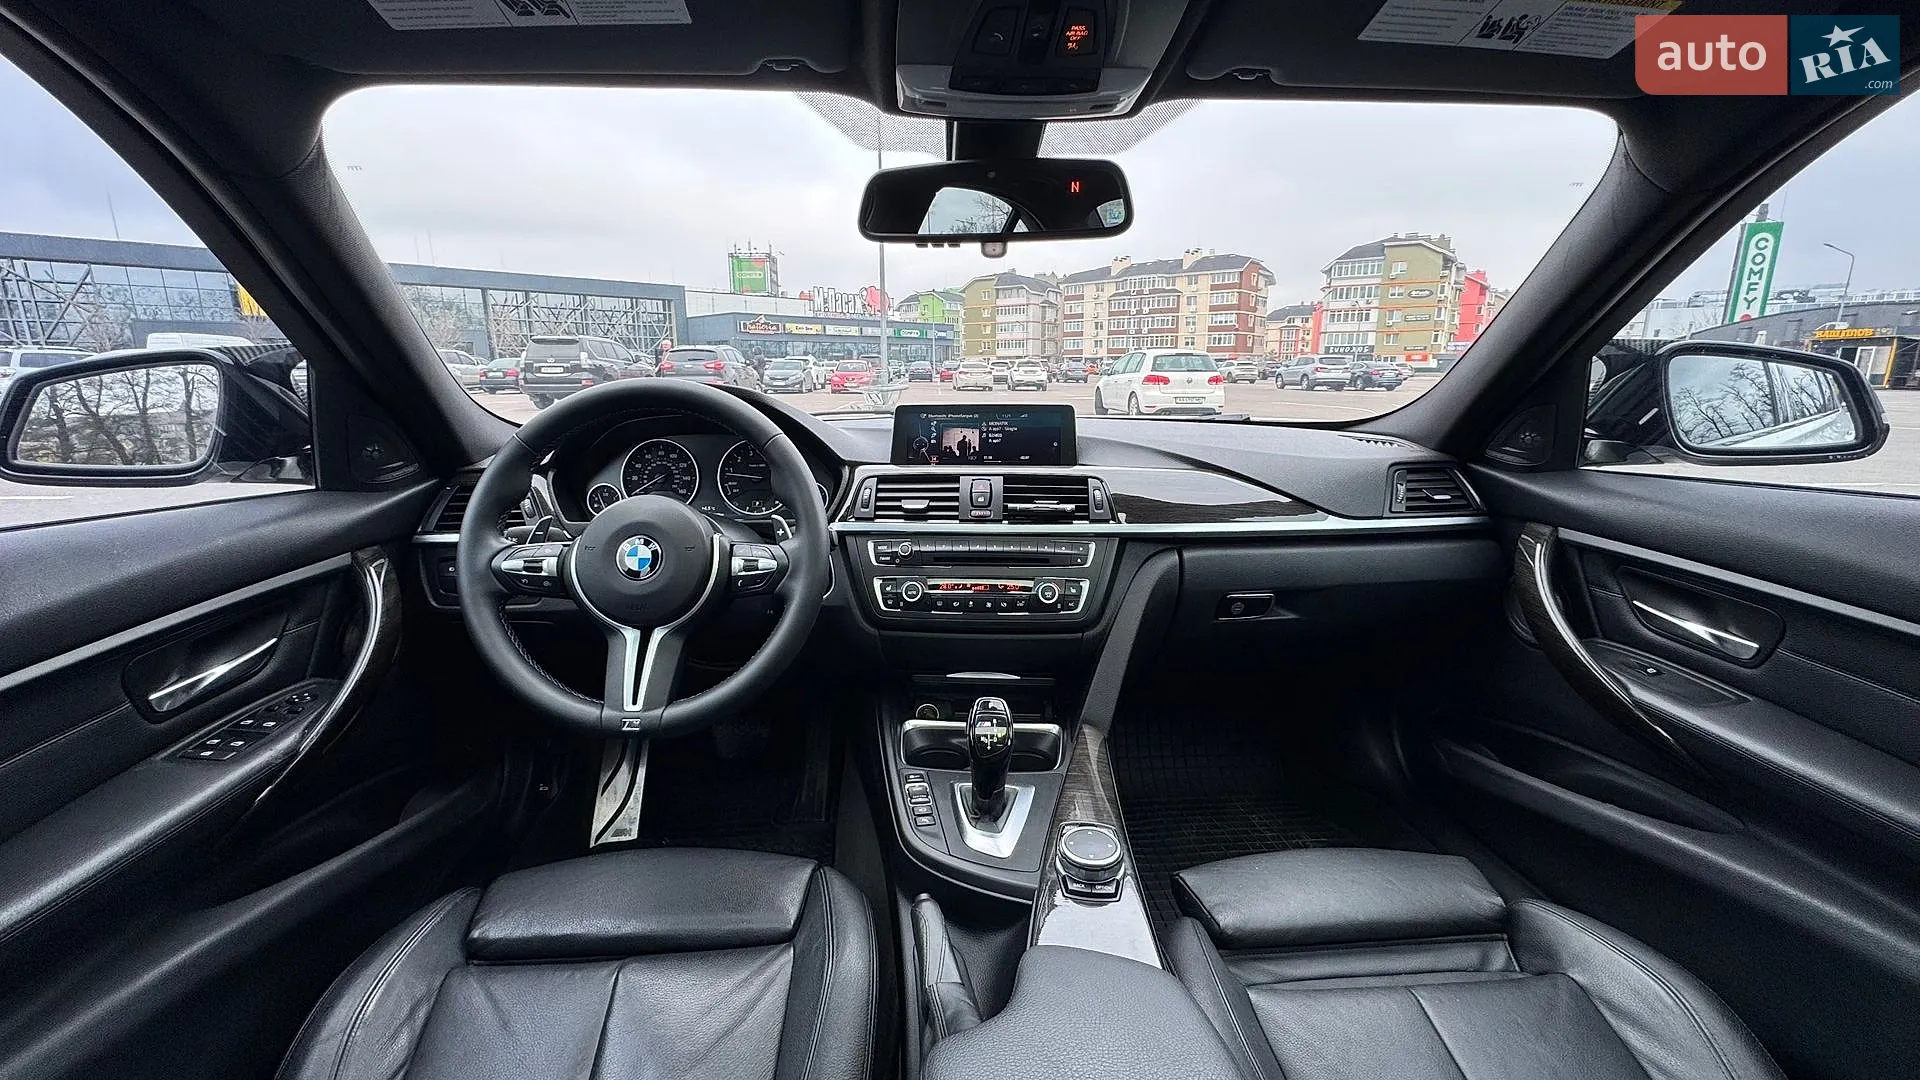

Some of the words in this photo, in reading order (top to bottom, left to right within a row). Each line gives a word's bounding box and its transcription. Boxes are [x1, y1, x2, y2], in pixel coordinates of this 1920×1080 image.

[1070, 181, 1080, 193] N
[1743, 236, 1770, 310] COMFY
[622, 538, 659, 551] BMW
